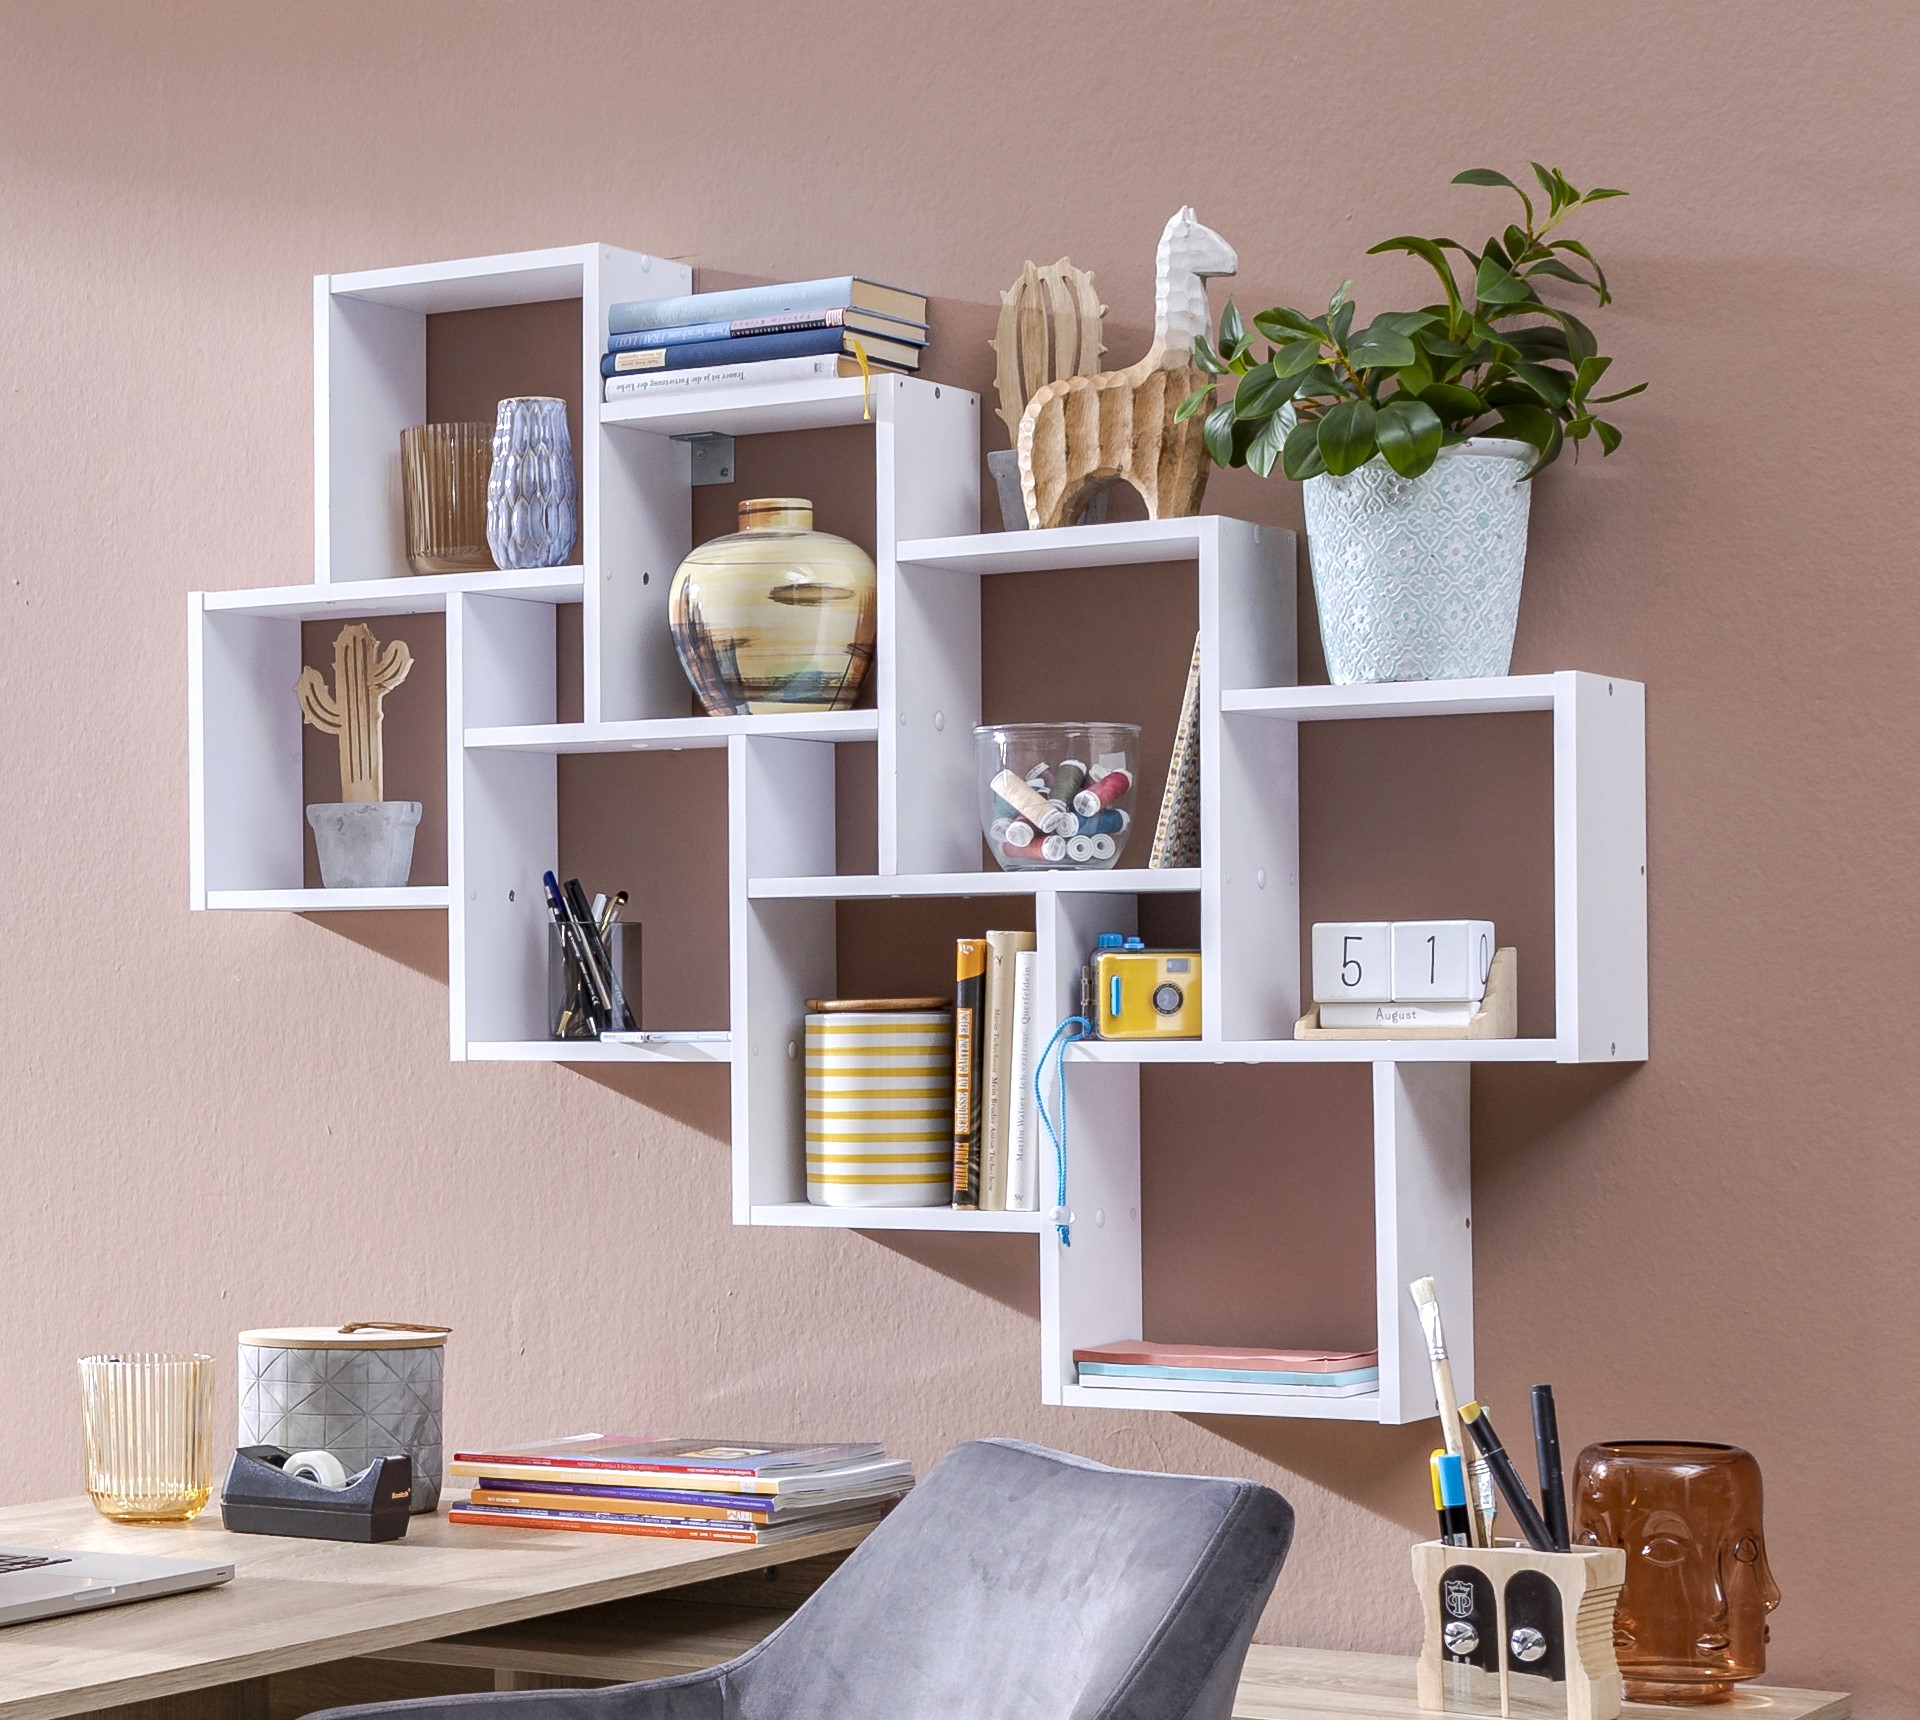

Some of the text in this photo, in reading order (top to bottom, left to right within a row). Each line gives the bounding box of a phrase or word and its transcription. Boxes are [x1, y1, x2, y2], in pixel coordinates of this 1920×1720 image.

[640, 332, 666, 346] FRAU
[616, 371, 746, 393] Trauer ist ja die Fortsetzung der Liebe
[1341, 935, 1363, 987] 5
[1426, 935, 1437, 985] 1
[1020, 966, 1032, 1025] Querfeldein
[1375, 1007, 1417, 1023] August
[991, 1077, 1000, 1097] Mein
[1018, 1073, 1028, 1091] Ich
[1016, 1097, 1027, 1128] Walser
[1015, 1129, 1026, 1162] Martin
